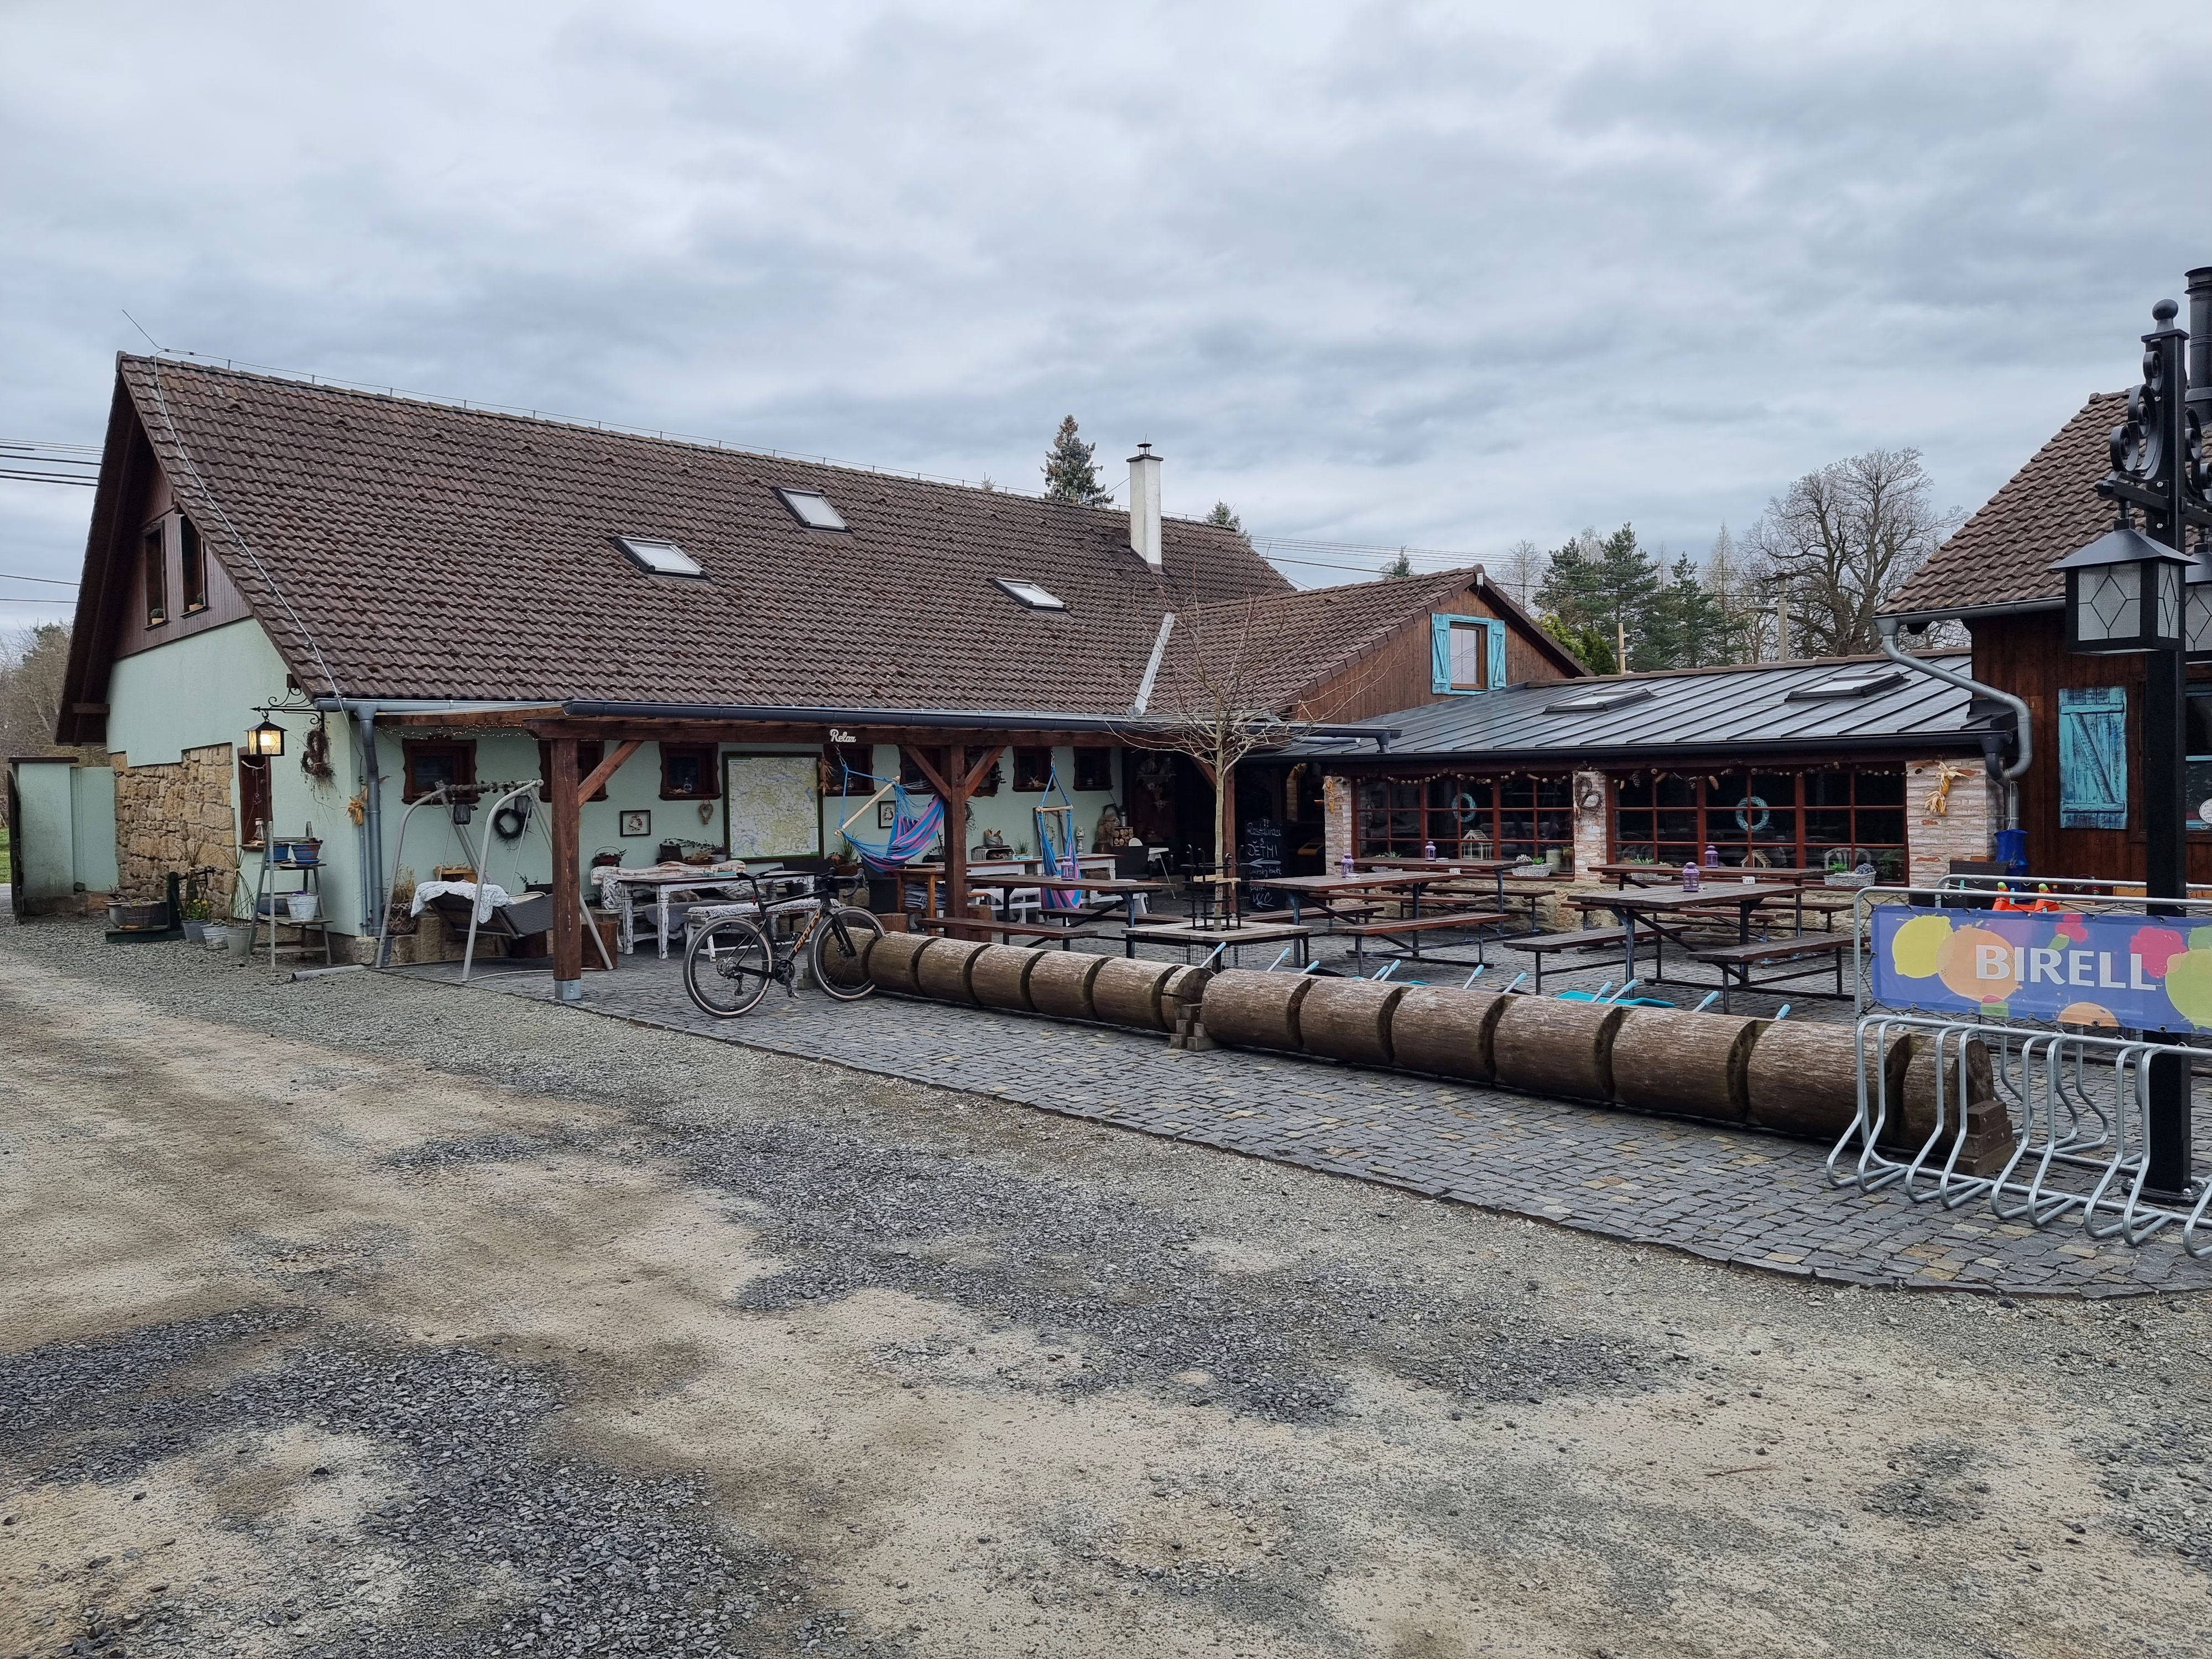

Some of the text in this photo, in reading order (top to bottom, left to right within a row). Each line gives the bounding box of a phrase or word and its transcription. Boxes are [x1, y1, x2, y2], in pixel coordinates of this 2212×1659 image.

[829, 729, 857, 743] Relax
[1253, 892, 1273, 903] WC
[794, 910, 820, 953] RIDLEY
[1975, 945, 2156, 991] BIRELL
